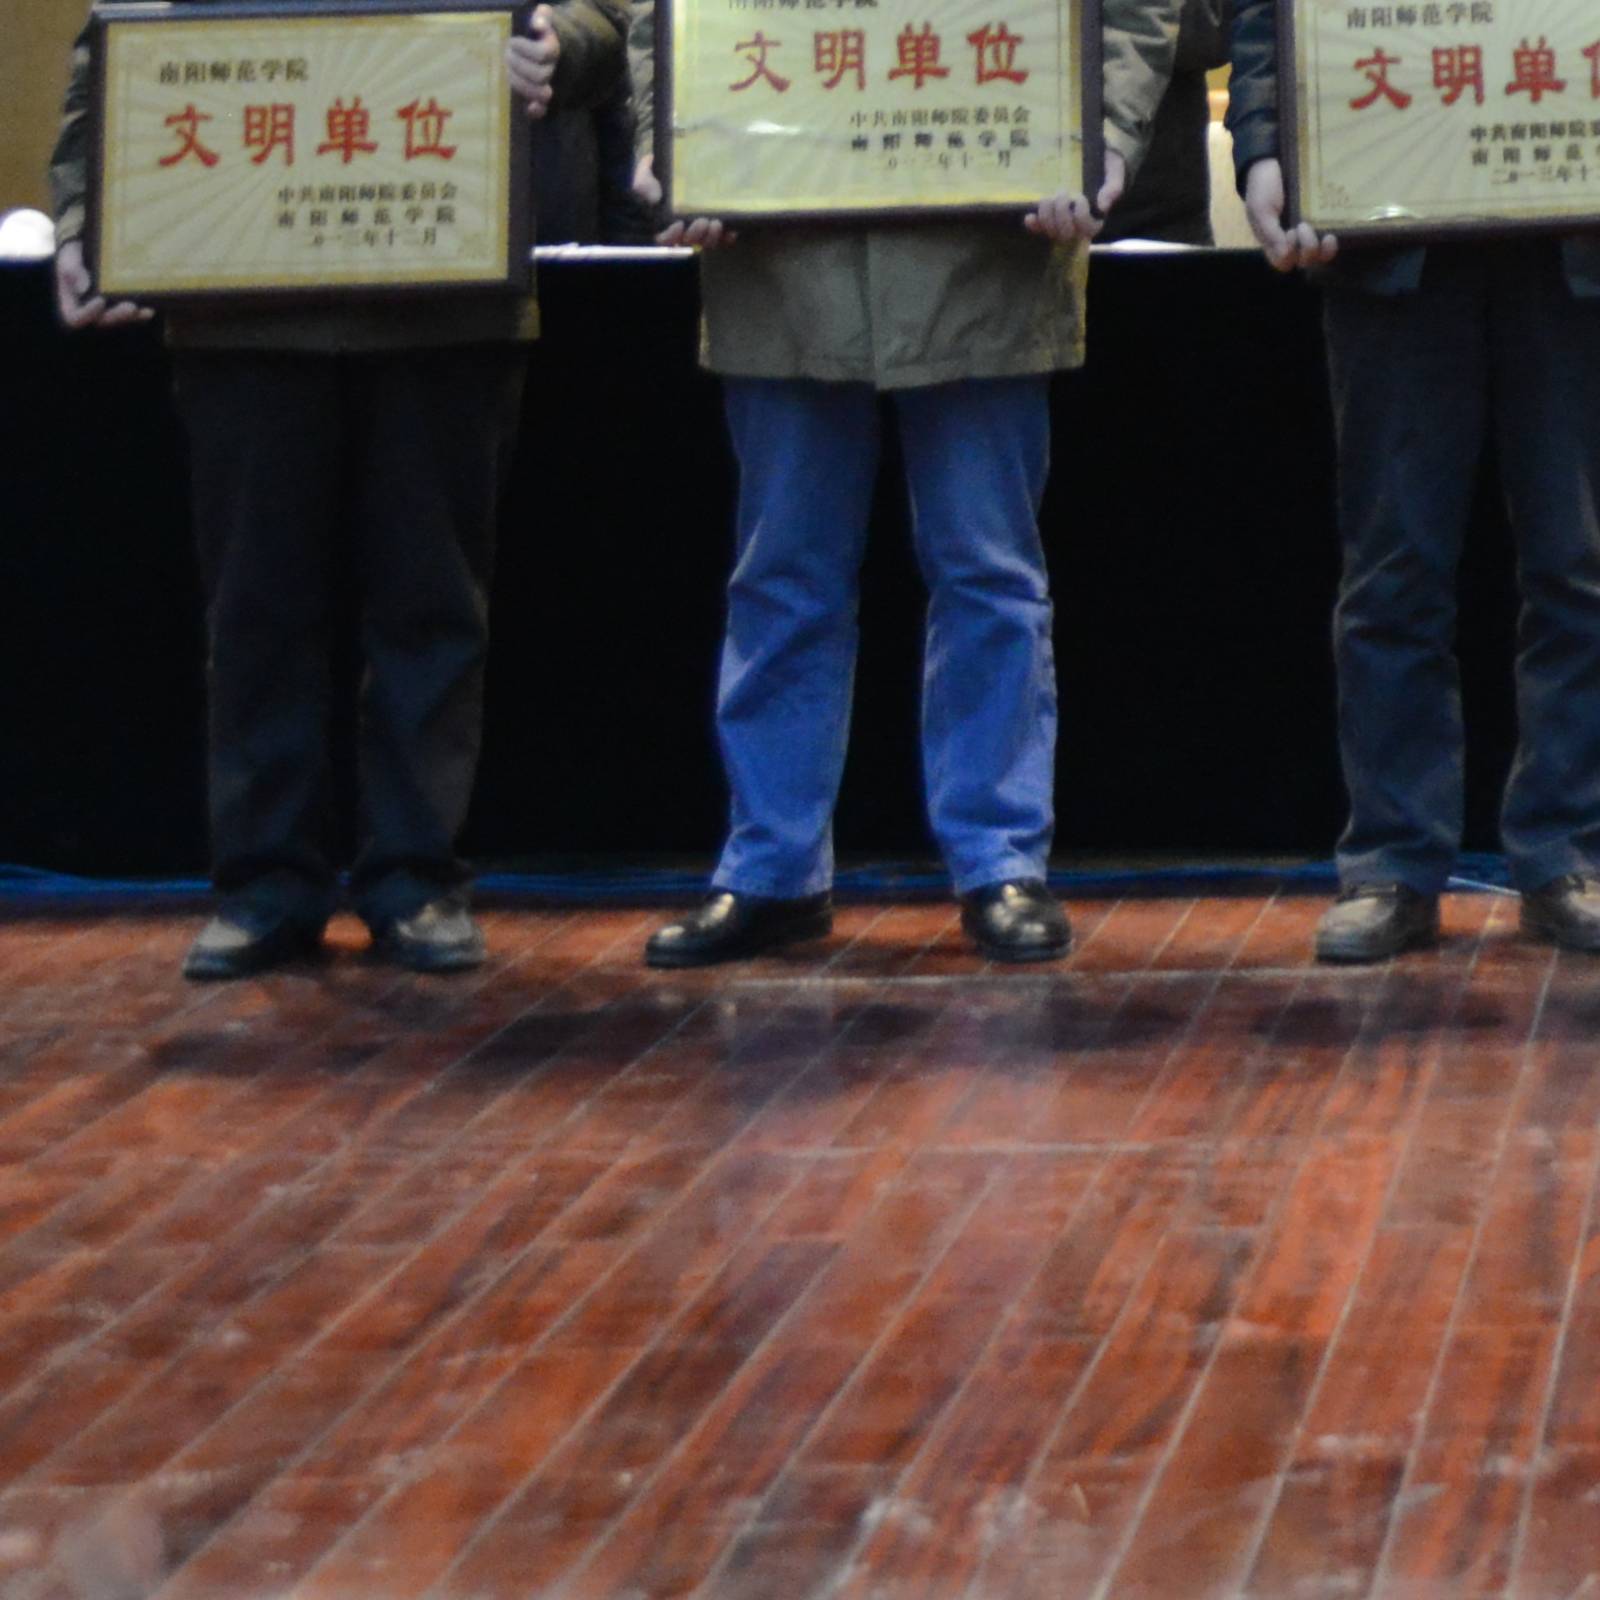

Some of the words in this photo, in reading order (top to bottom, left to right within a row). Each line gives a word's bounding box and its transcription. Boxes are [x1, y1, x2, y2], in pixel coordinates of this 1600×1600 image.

[1347, 0, 1493, 29] 南阳师范学院
[728, 20, 1030, 92] 文明单位
[159, 58, 310, 84] 南阳师范学院
[850, 106, 1031, 127] 中共南阳师院委员会
[158, 95, 457, 167] 文明单位
[851, 130, 1030, 151] 南阳师范学院
[277, 181, 458, 203] 中共南阳师院委员会
[277, 206, 456, 228] 南阳师范学院
